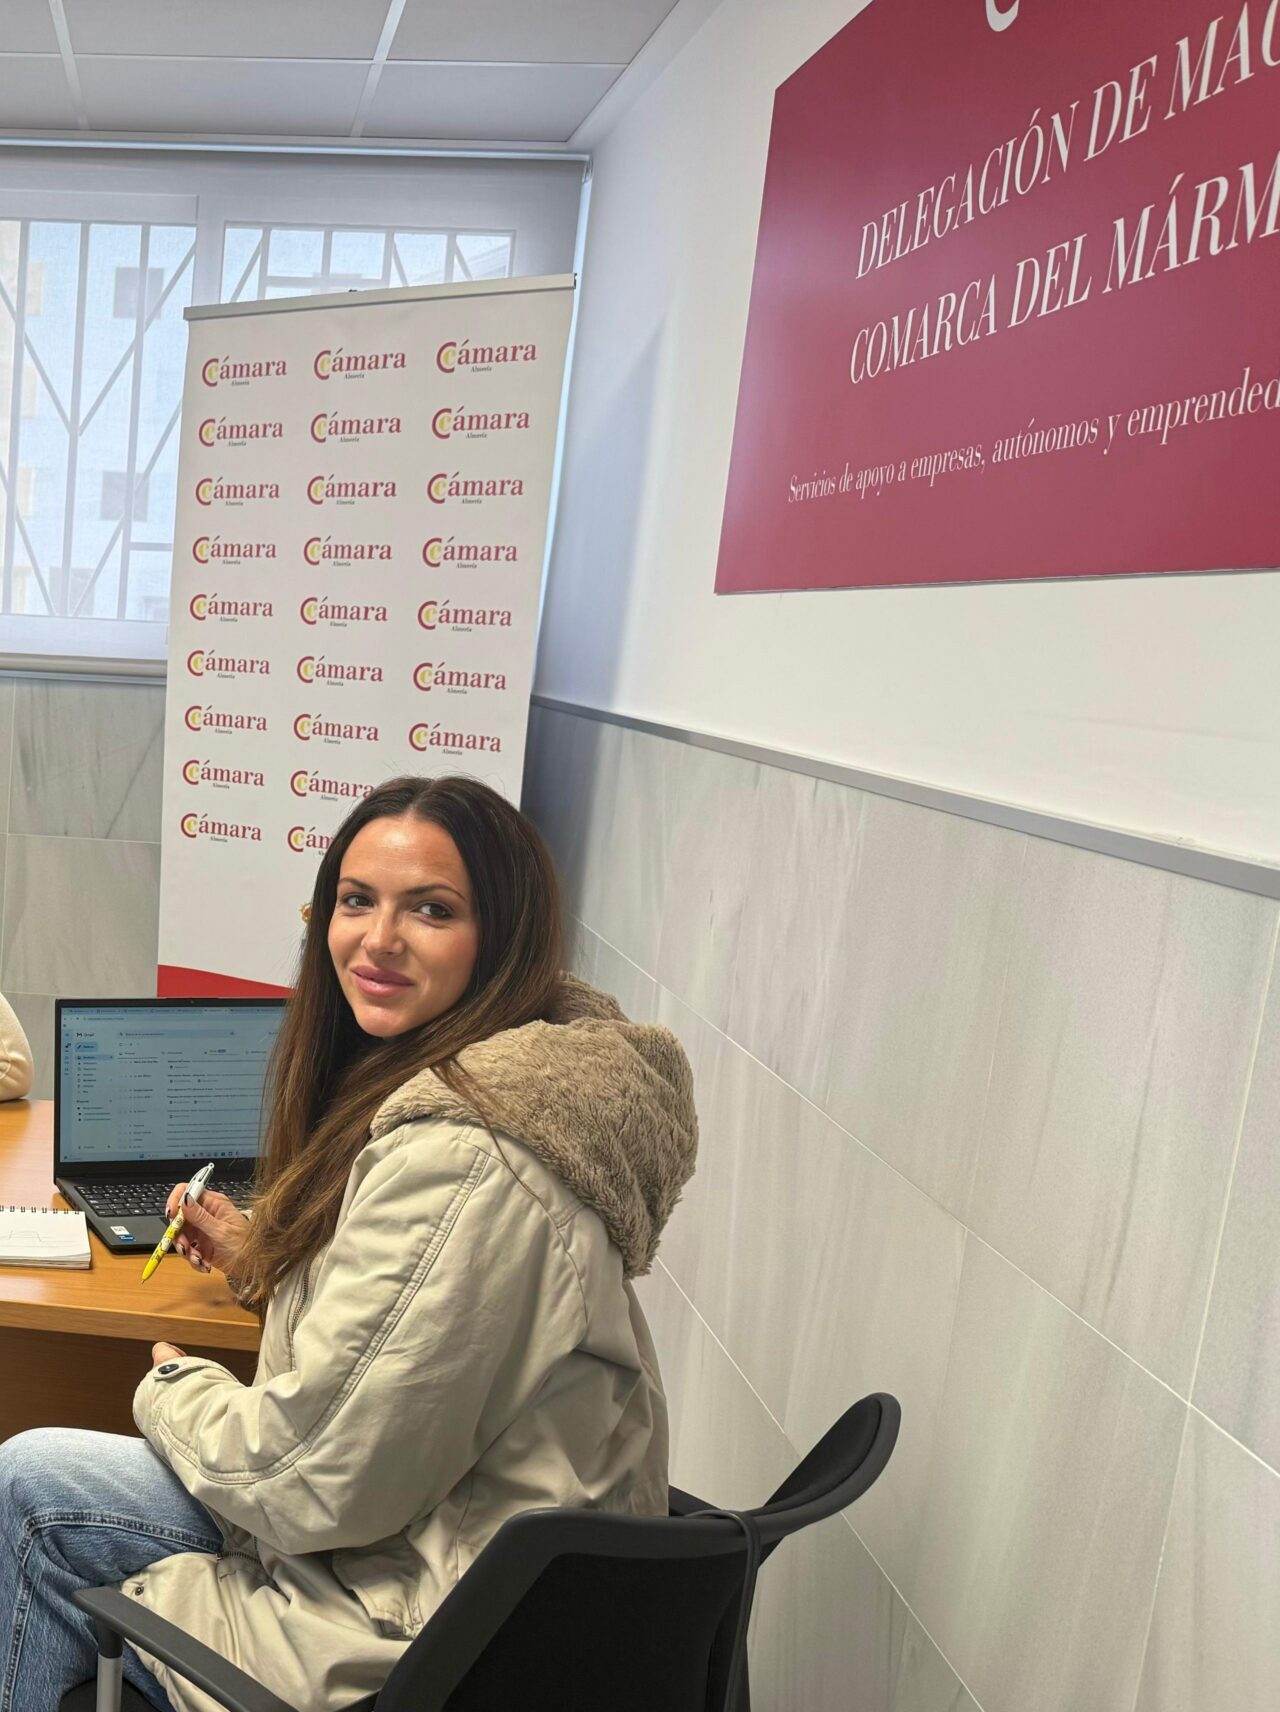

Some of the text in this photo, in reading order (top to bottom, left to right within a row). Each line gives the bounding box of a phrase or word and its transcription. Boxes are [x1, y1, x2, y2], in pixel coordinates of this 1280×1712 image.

[855, 100, 1079, 280] DELEGACIÓN
[1083, 54, 1158, 162] DE
[849, 272, 998, 384] COMARCA
[1007, 233, 1093, 329] DEL
[313, 348, 406, 380] Cámara
[436, 338, 537, 374] Cámara
[202, 356, 287, 387] Cámara
[199, 416, 282, 447] Cámara
[310, 411, 401, 443] Cámara
[432, 406, 529, 439] Cámara
[788, 470, 837, 503] Servicios
[838, 463, 853, 493] de
[856, 463, 895, 500] apoyo
[897, 460, 906, 483] a
[910, 443, 986, 488] empresas,
[992, 418, 1098, 463] autónomos
[1103, 412, 1123, 456] y
[195, 476, 279, 506] Cámara
[307, 474, 396, 505] Cámara
[427, 472, 523, 504] Cámara
[192, 535, 276, 564] Cámara
[303, 536, 391, 566] Cámara
[422, 536, 517, 568] Cámara
[190, 593, 273, 621] Cámara
[300, 596, 388, 625] Cámara
[417, 600, 511, 630] Cámara
[187, 650, 269, 677] Cámara
[297, 656, 383, 683] Cámara
[413, 662, 506, 692] Cámara
[185, 705, 267, 732] Cámara
[293, 713, 379, 741] Cámara
[408, 723, 501, 752] Cámara
[182, 760, 264, 785] Cámara
[180, 813, 262, 840] Cámara
